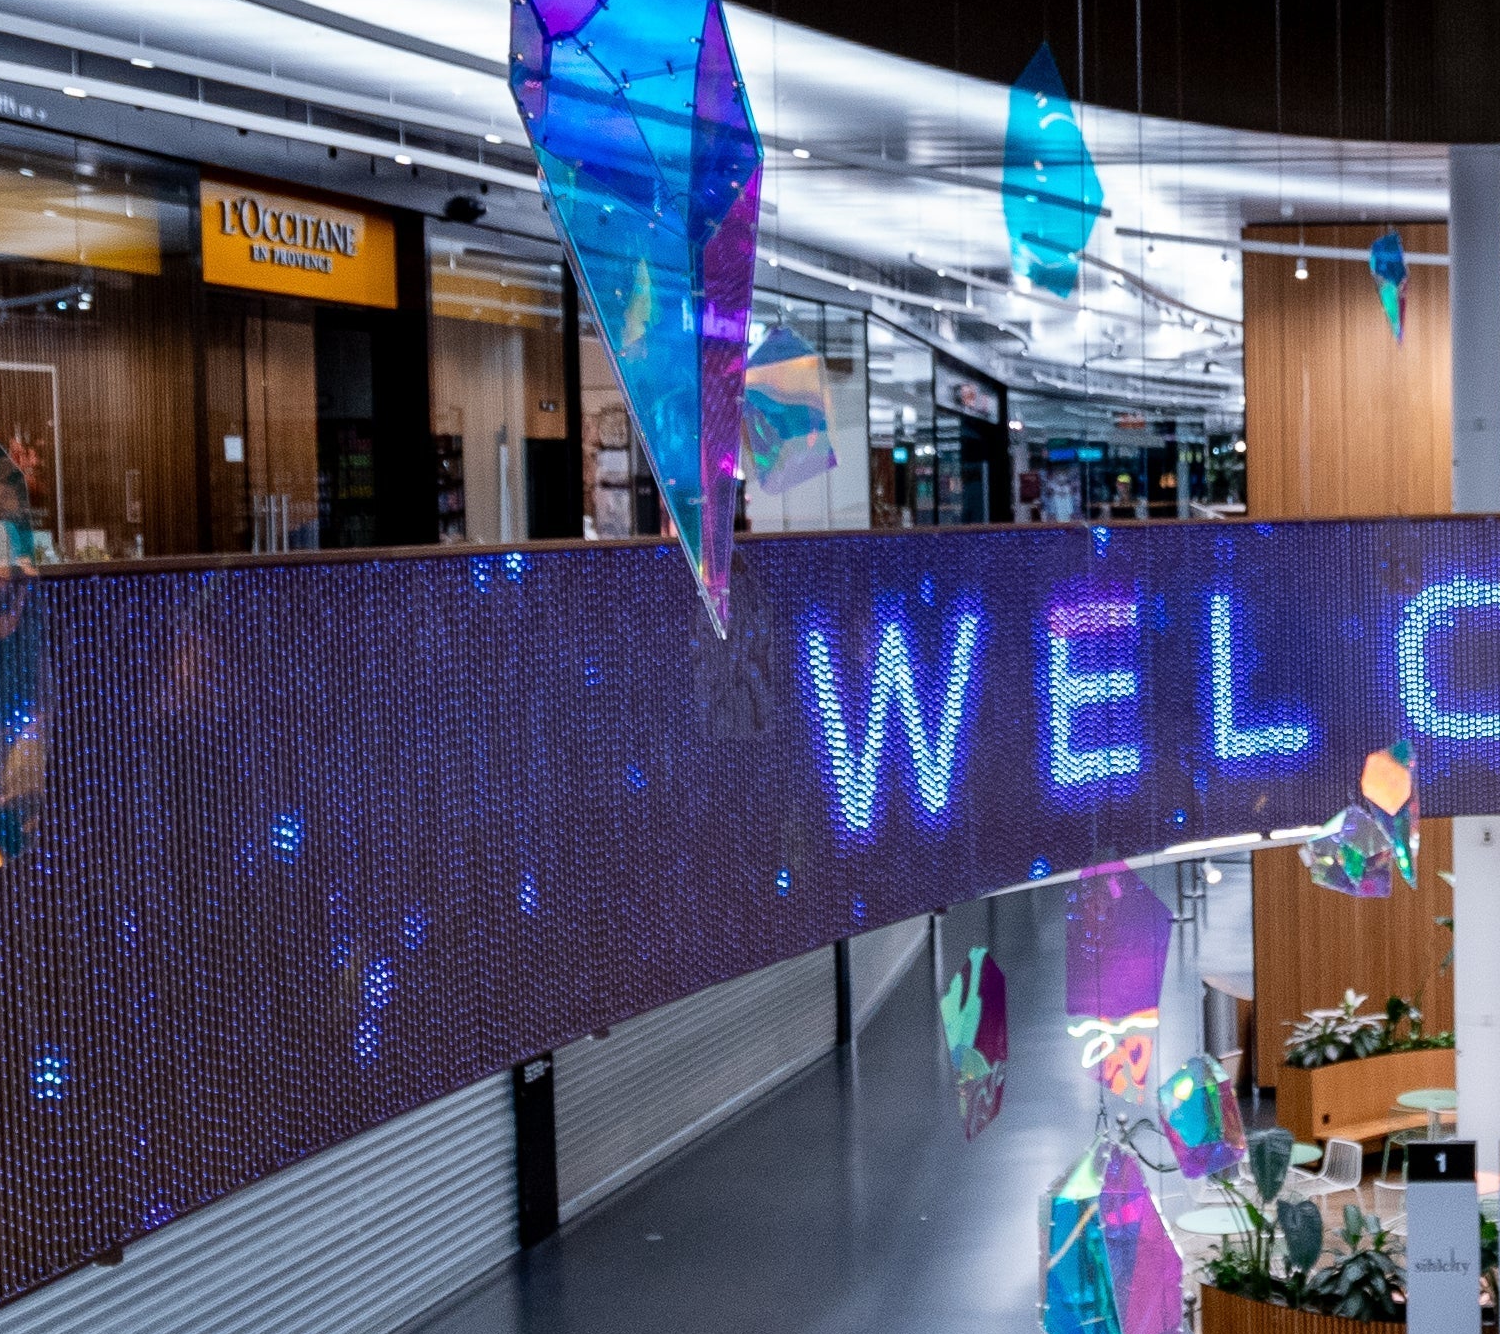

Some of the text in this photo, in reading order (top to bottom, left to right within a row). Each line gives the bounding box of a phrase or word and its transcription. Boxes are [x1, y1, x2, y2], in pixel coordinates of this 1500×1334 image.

[219, 196, 358, 257] L'OCCITANE
[252, 243, 333, 274] EN PROVENCE
[1434, 1151, 1448, 1173] 1
